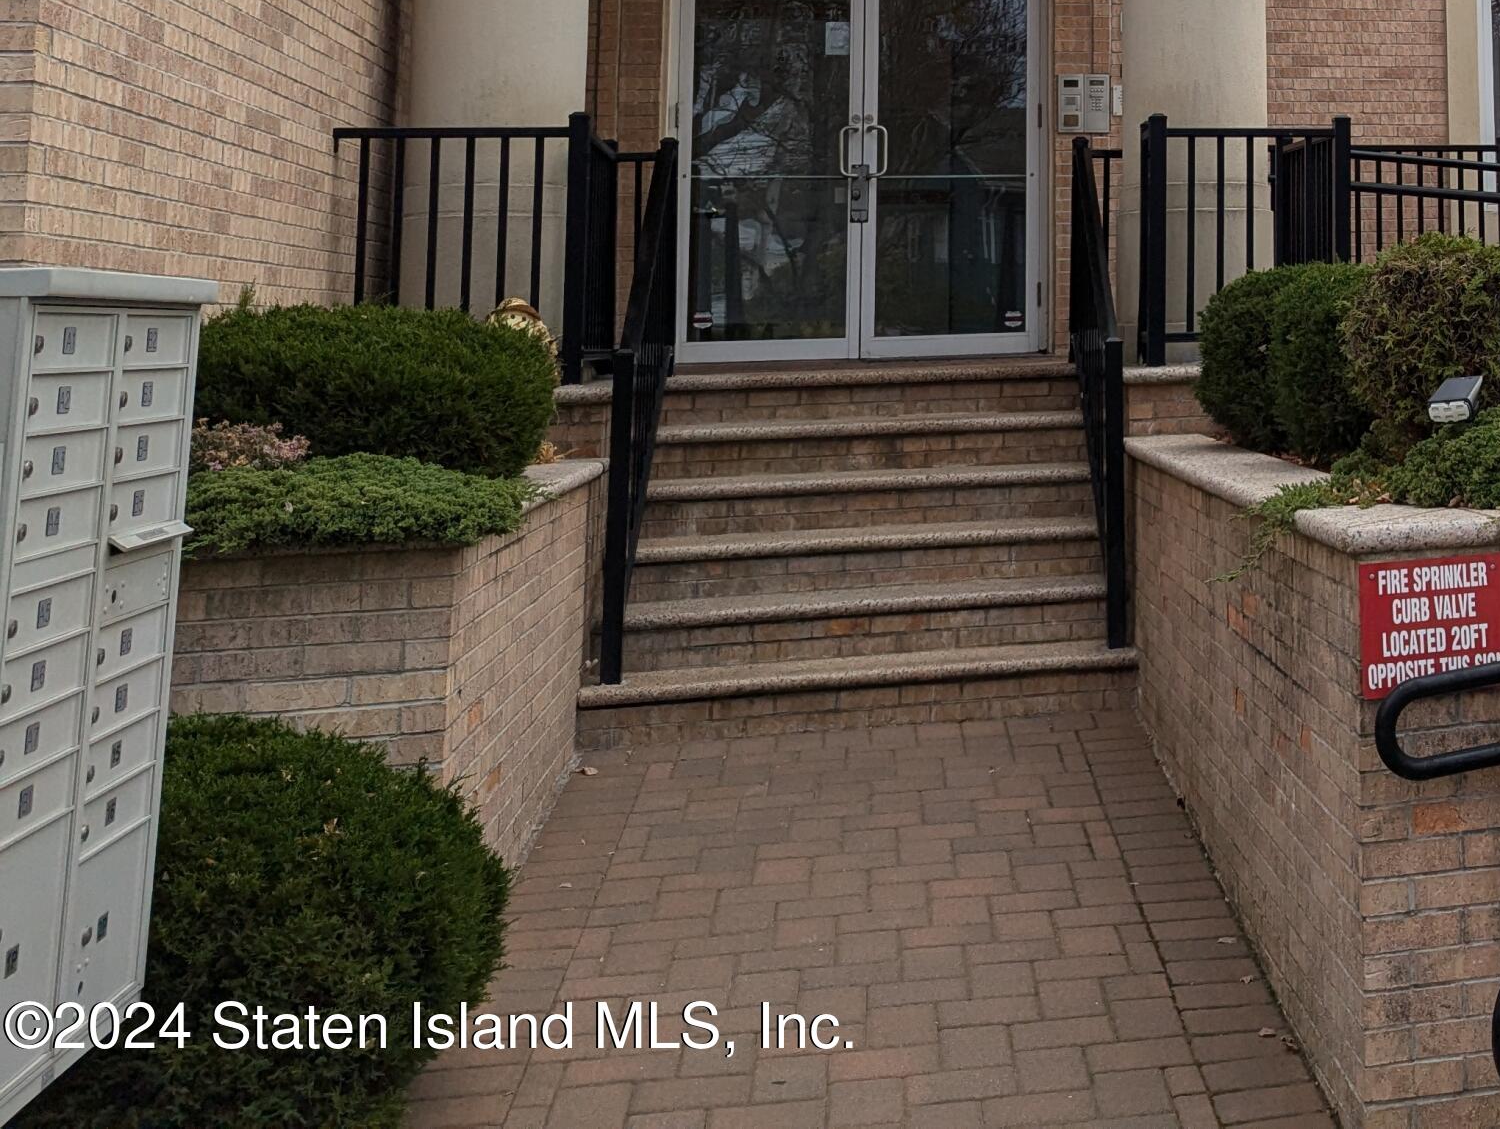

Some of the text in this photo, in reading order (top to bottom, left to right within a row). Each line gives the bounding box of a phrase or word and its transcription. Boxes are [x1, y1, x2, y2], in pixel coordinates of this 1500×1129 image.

[64, 328, 76, 352] A1
[147, 329, 158, 350] B2
[59, 388, 71, 411] A2
[48, 509, 60, 532] A4
[1377, 562, 1488, 595] FIRE SPRINKLER
[1392, 593, 1477, 624] CURB VALVE
[1382, 623, 1488, 658] LOCATED 20FT
[33, 663, 45, 688] A6
[1368, 658, 1435, 690] OPPOSITE
[26, 724, 39, 752] A7
